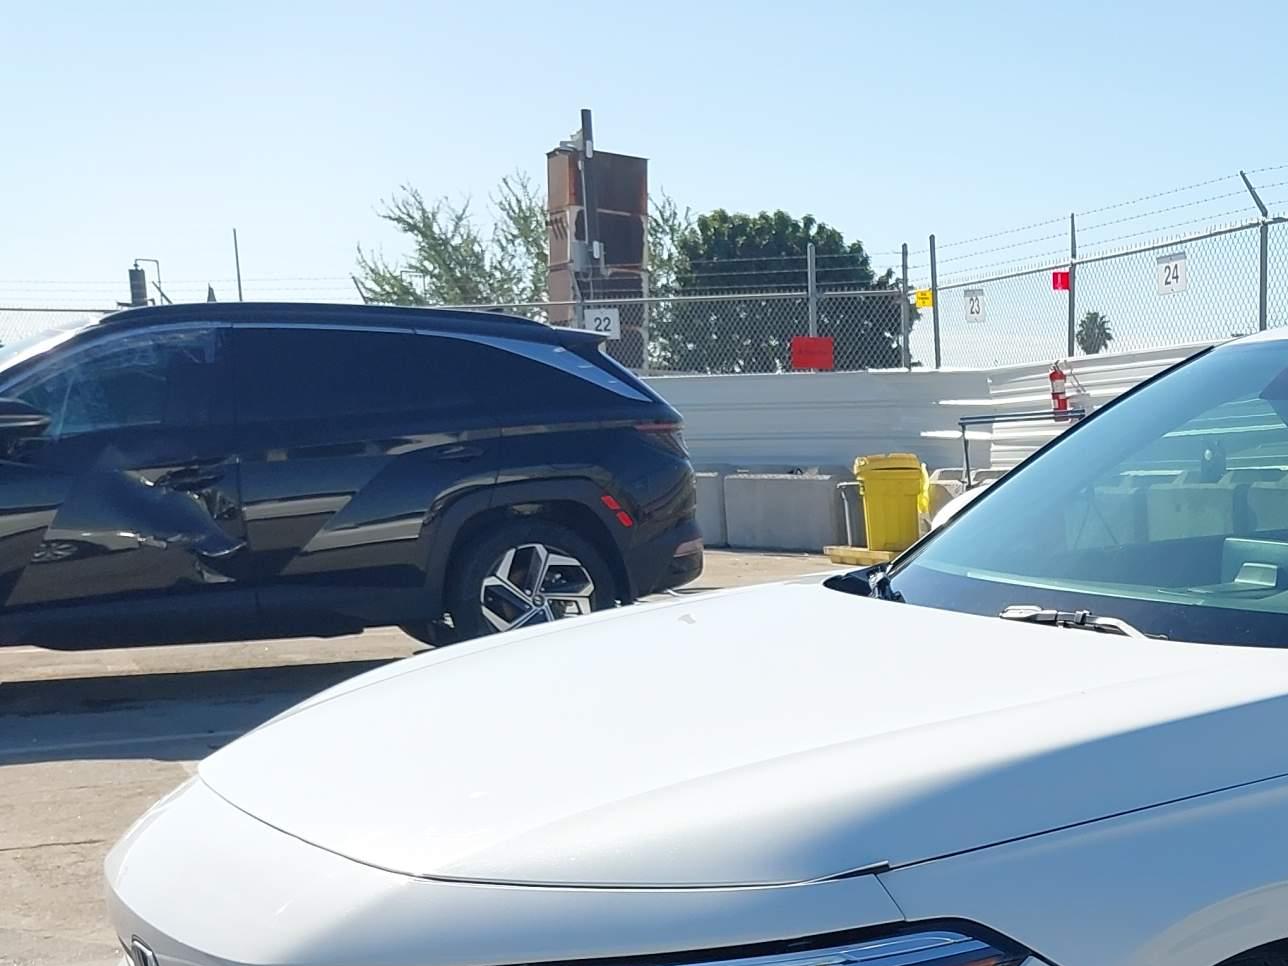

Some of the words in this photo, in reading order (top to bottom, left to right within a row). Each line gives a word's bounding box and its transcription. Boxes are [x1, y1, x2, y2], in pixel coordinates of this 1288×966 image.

[1164, 263, 1179, 286] 24
[969, 296, 981, 315] 23
[594, 316, 612, 332] 22
